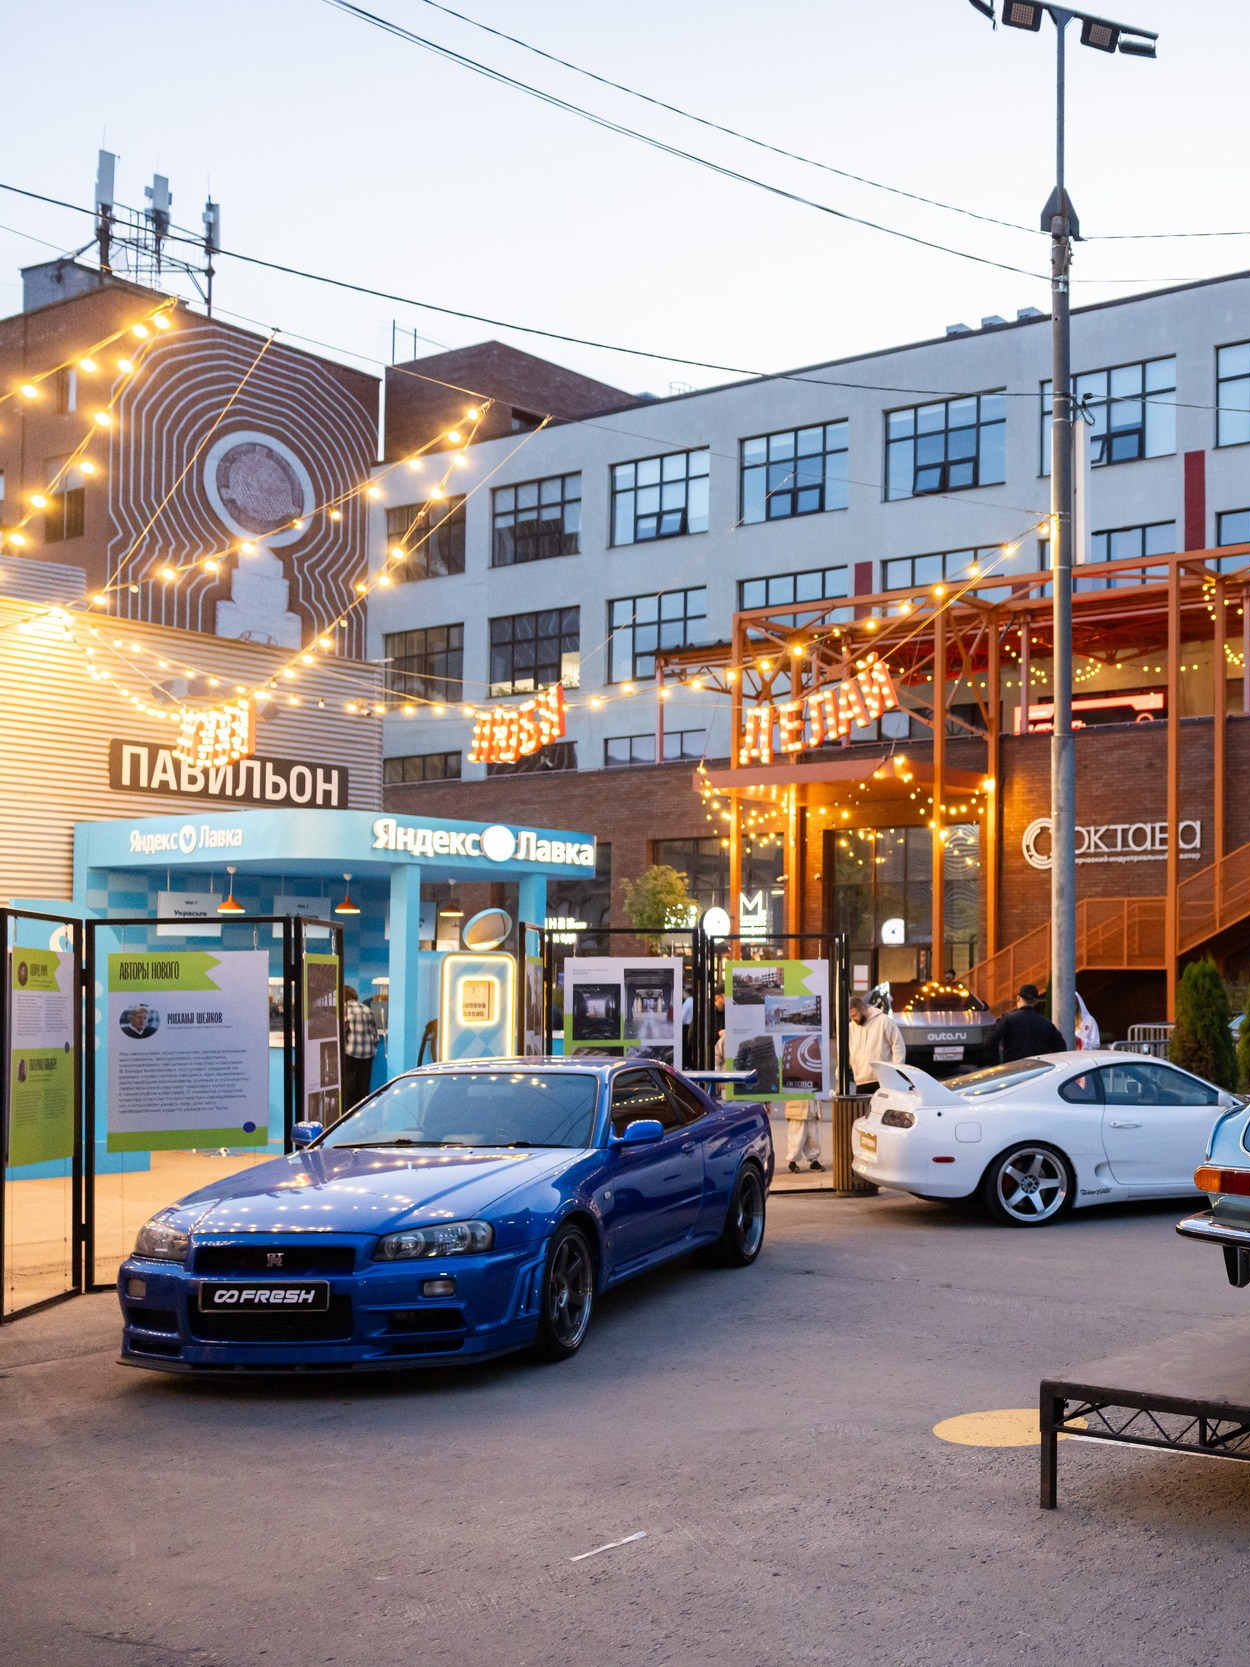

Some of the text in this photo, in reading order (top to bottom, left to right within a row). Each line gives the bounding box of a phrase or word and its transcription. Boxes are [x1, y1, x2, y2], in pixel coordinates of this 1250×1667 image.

[121, 744, 339, 806] ПАВИЛЬОН
[130, 824, 243, 854] Яндекс Лавка
[372, 818, 594, 866] Яндекс Лавка
[119, 961, 180, 980] АВТОРЫ НОВОГО
[927, 1032, 967, 1041] auto.ru
